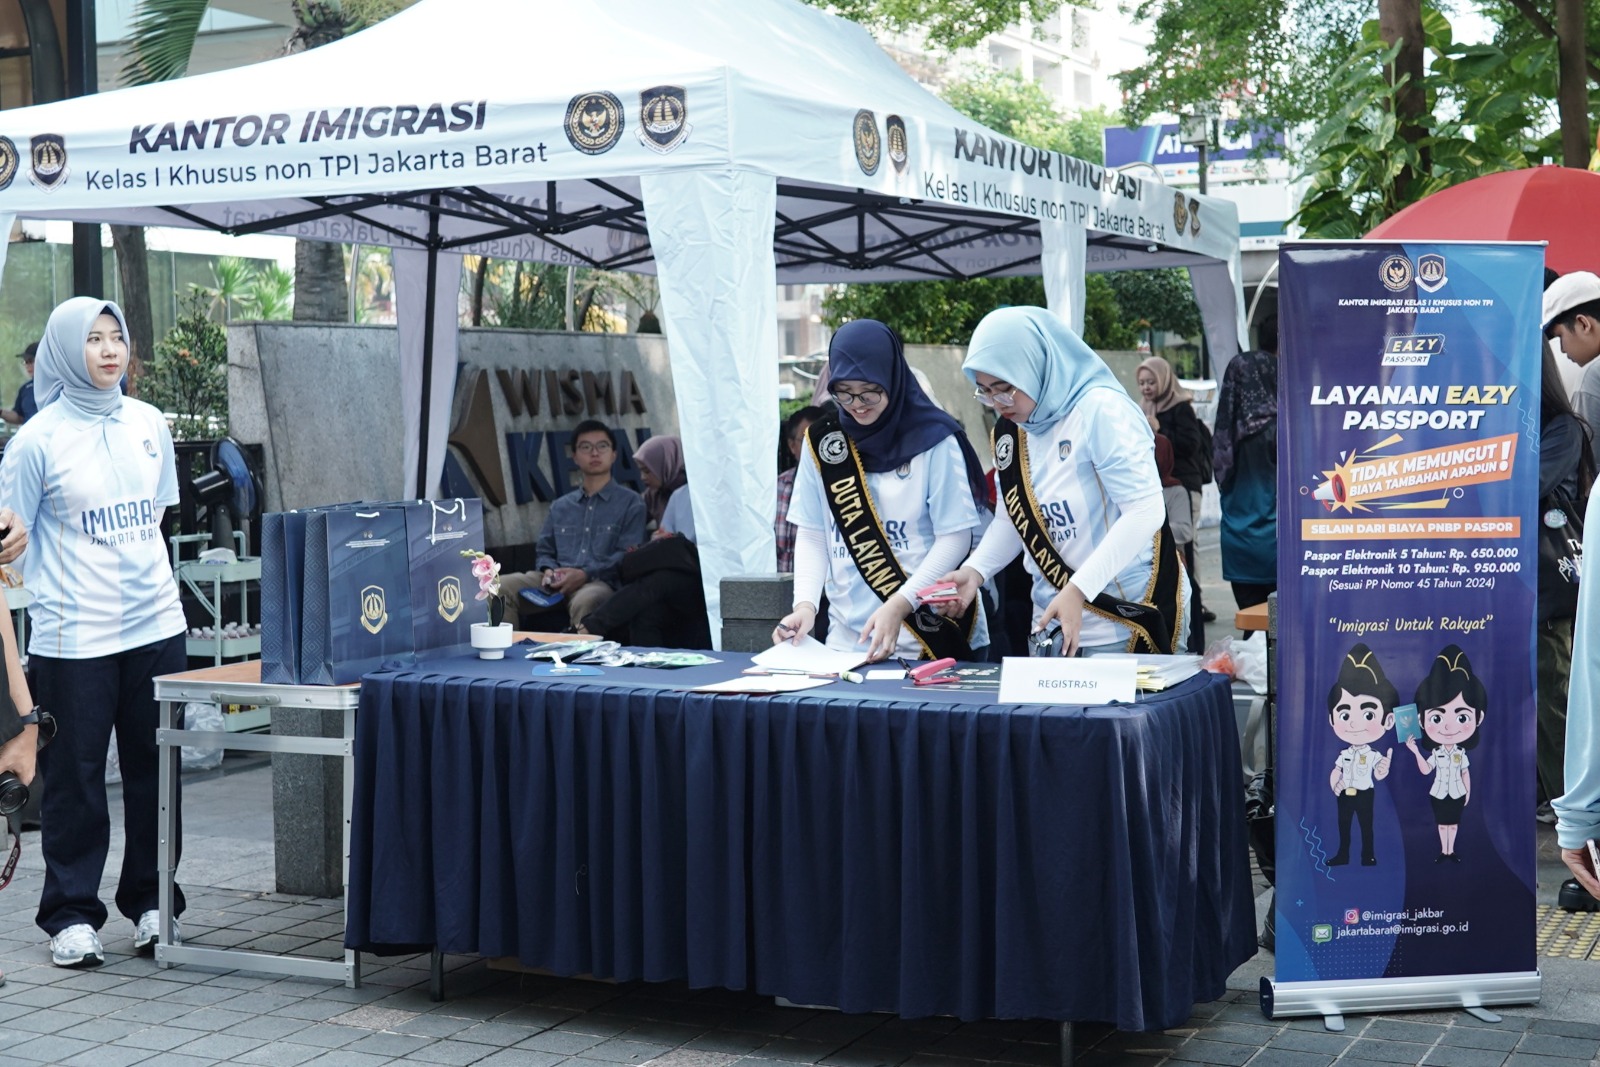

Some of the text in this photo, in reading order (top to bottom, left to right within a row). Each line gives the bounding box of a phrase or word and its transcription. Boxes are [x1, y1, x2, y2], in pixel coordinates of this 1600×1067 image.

[129, 100, 487, 154] KANTOR IMIGRASI
[86, 142, 549, 191] Kelas I Khusus non TPI Jakarta Barat
[954, 127, 1142, 201] KANTOR IMIGRASI
[924, 171, 1166, 243] Kelas I Khusus non TPI Jakarta Barat
[1386, 306, 1445, 315] JAKARTA BARAT
[1392, 338, 1439, 352] EAZY
[1384, 355, 1428, 363] PASSPORT
[495, 368, 648, 418] WISMA
[1310, 385, 1518, 405] LAYANAN EAZY
[1343, 410, 1486, 430] PASSPORT
[1350, 461, 1399, 483] TIDAK
[1402, 443, 1498, 473] MEMUNGUT
[1349, 461, 1497, 497] BIAYA TAMBAHAN APAPUN
[830, 475, 864, 528] DUTA
[1005, 484, 1030, 539] DUTA
[1311, 522, 1513, 534] SELAIN DARI BIAYA PNBP PASPOR
[1304, 548, 1519, 563] Paspor Elektronik 5 Tahun: Rp. 650.000
[1300, 562, 1521, 578] Paspor Elektronik 10 Tahun: Rp. 950.000
[1328, 577, 1496, 592] (Sesuai PP Nomor 45 Tahun 2024)
[1395, 617, 1434, 632] Untuk
[1038, 679, 1098, 689] REGISTRASI
[1362, 908, 1444, 923] @imigrasi_jakbar
[1336, 921, 1469, 939] jakartabarat@imigrasi.go.id
